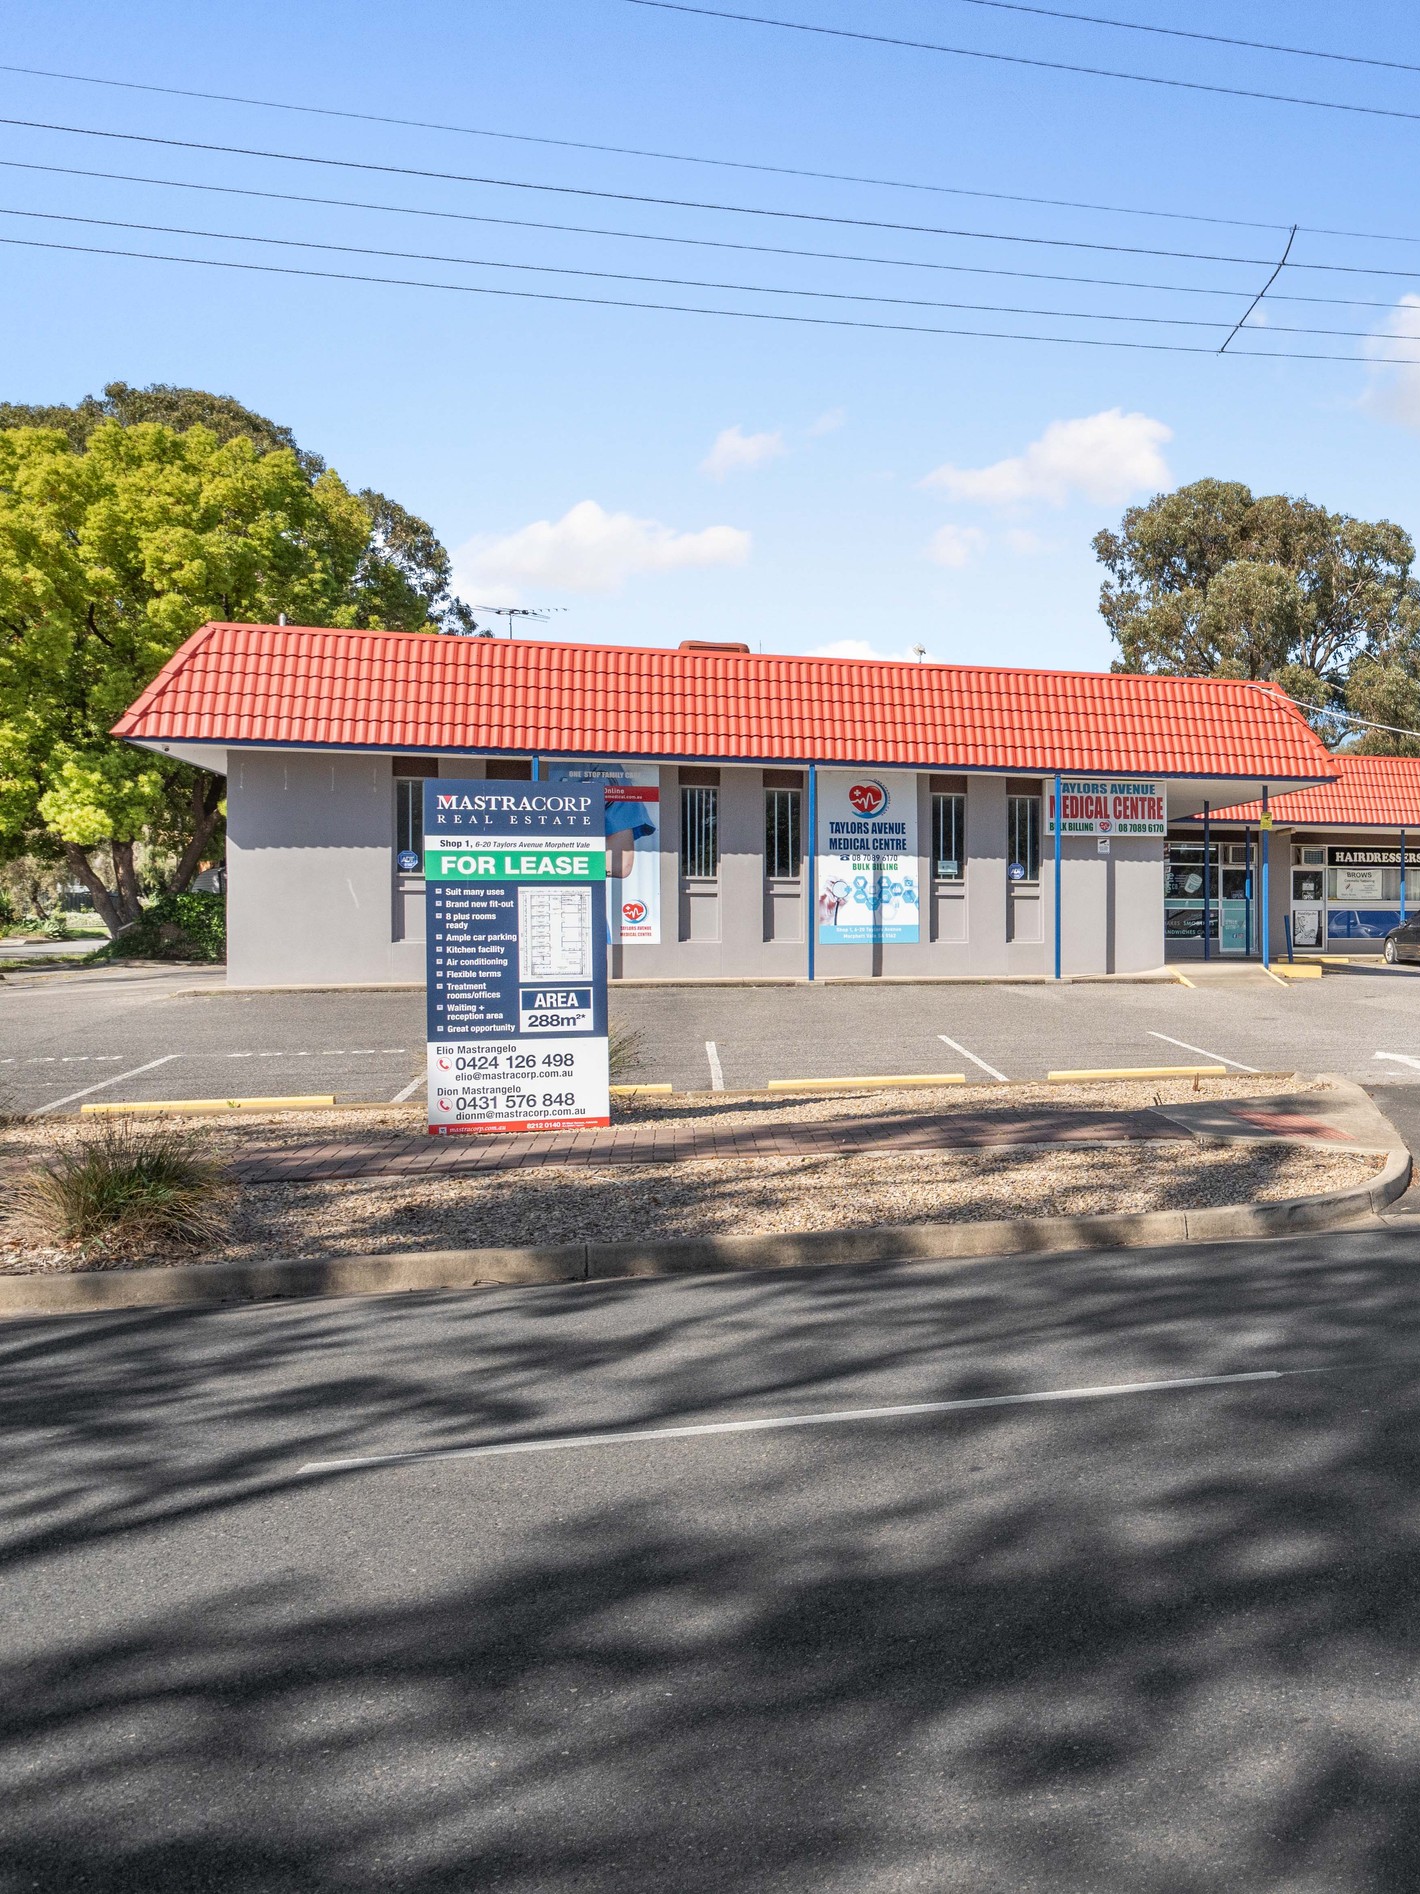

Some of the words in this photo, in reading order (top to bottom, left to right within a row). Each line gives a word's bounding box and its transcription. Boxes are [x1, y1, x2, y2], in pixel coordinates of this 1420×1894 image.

[602, 771, 624, 779] FAMILY
[1060, 783, 1107, 794] AYLORS
[1110, 784, 1155, 795] AVENUE
[437, 795, 591, 812] MASTRACORP
[1113, 796, 1163, 820] CENTRE
[437, 815, 493, 824] REAL
[510, 816, 591, 825] ESTATE
[829, 822, 869, 834] TAYLORS
[871, 822, 906, 835] AVENUE
[1049, 822, 1067, 831] BLK
[1068, 822, 1094, 831] BILLING
[1118, 823, 1128, 832] 08
[1129, 823, 1146, 833] 7089
[1148, 824, 1164, 833] 6170
[440, 840, 462, 849] Shop
[465, 840, 473, 849] 1,
[493, 841, 517, 849] Taylors
[829, 838, 870, 850] MEDICAL
[872, 838, 907, 850] CENTRE
[441, 856, 496, 875] FOR
[504, 856, 589, 875] LEASE
[446, 888, 462, 896] Suit
[463, 889, 484, 897] many
[446, 900, 469, 908] Brand
[489, 900, 514, 908] fit-out
[453, 913, 470, 921] plus
[446, 922, 468, 930] ready
[446, 933, 471, 942] Ample
[488, 933, 517, 942] parking
[446, 946, 476, 954] Kitchen
[478, 946, 505, 954] facility
[446, 958, 458, 966] Air
[460, 958, 508, 966] conditioning
[447, 970, 477, 978] Flexible
[447, 991, 501, 999] rooms/offices
[534, 993, 579, 1008] AREA
[447, 1004, 477, 1012] Waiting
[447, 1013, 484, 1021] reception
[447, 1025, 469, 1033] Great
[470, 1024, 515, 1034] opportunity
[436, 1046, 454, 1055] Elio
[457, 1044, 517, 1055] Mastrangelo
[455, 1056, 499, 1071] 0424
[506, 1054, 537, 1069] 126
[542, 1053, 575, 1067] 498
[455, 1070, 573, 1082] elio@mastracorp.com.au
[437, 1087, 458, 1096] Dion
[462, 1085, 522, 1096] Mastrangelo
[456, 1096, 498, 1111] 0431
[505, 1094, 537, 1109] 576
[543, 1092, 575, 1107] 848
[456, 1107, 586, 1121] dionm@mastracorp.com.au
[527, 1122, 543, 1130] 8212
[544, 1121, 561, 1129] 0140
